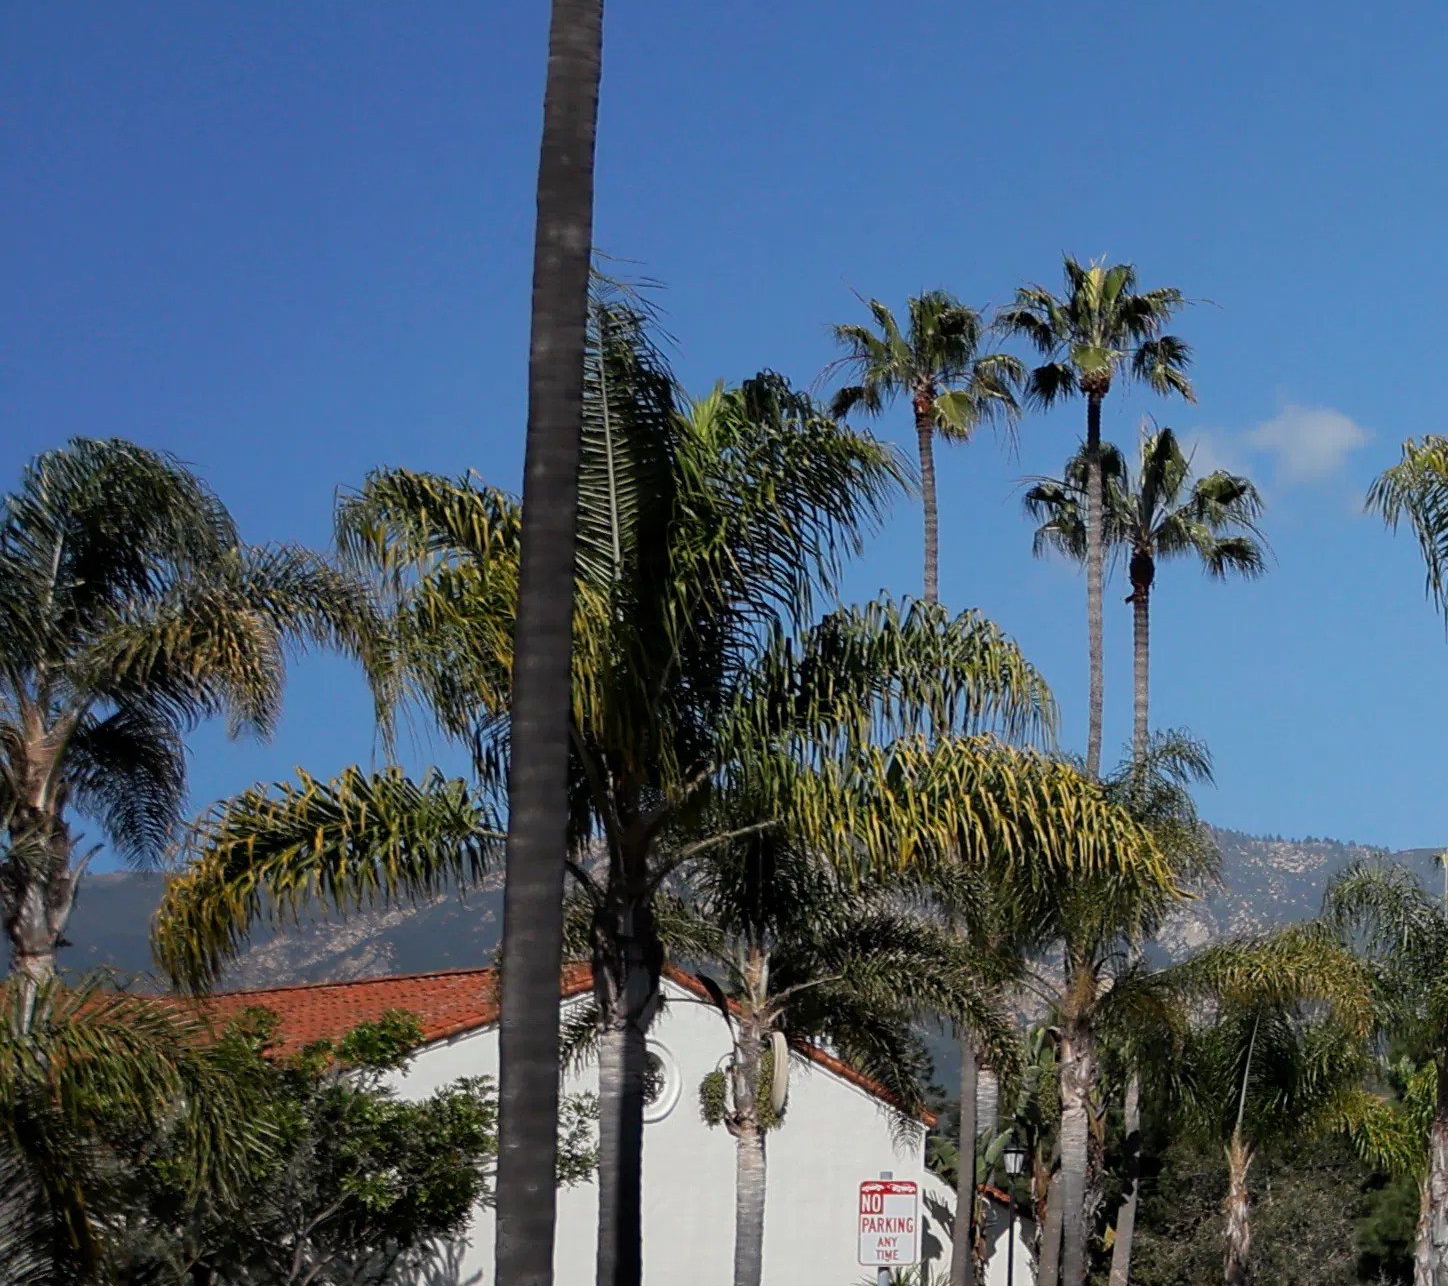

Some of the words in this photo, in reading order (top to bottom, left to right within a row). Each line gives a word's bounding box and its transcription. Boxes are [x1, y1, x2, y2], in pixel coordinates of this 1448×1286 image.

[861, 1194, 881, 1213] NO
[862, 1217, 914, 1233] PARKING
[877, 1236, 898, 1248] ANY
[875, 1249, 899, 1261] TIME
